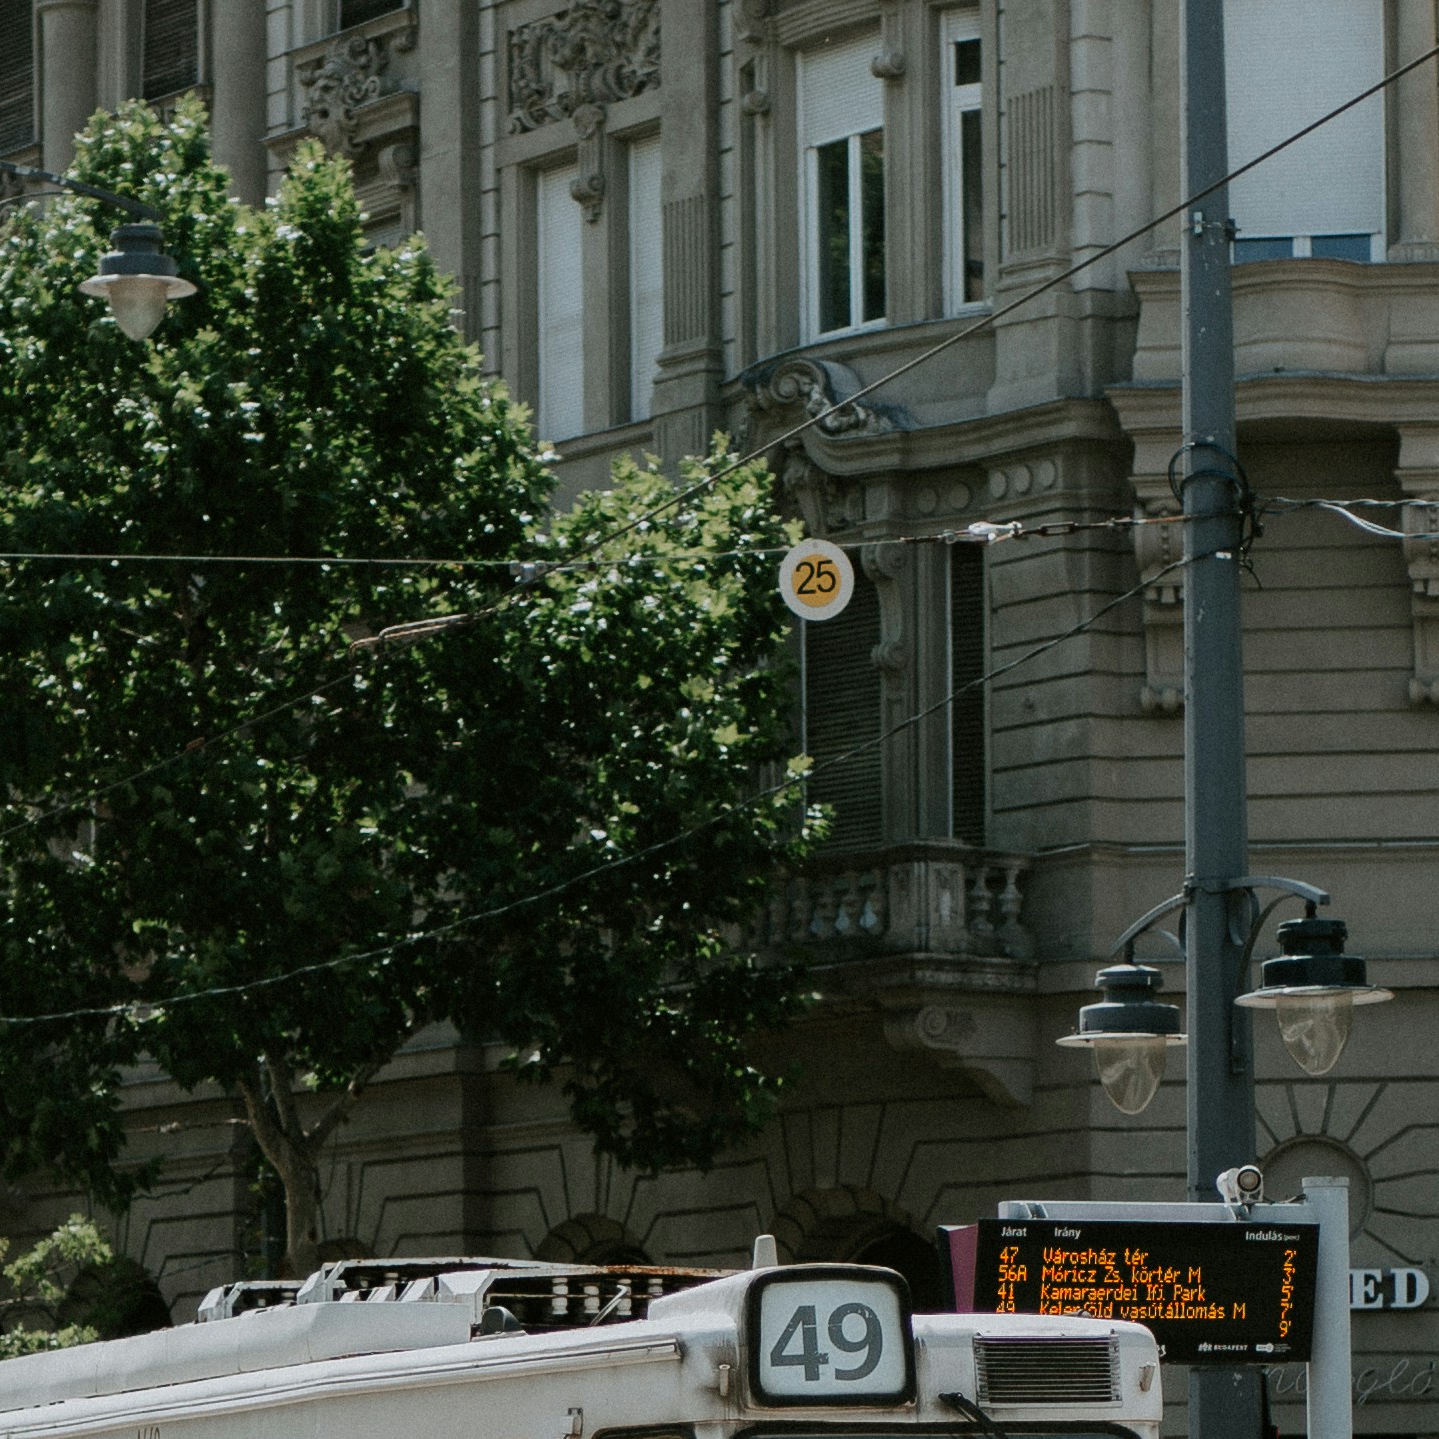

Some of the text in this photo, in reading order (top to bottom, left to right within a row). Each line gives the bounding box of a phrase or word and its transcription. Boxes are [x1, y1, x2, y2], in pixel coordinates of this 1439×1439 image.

[795, 560, 837, 595] 25
[1001, 1227, 1027, 1238] Járat
[1054, 1226, 1081, 1240] Irány
[1245, 1230, 1282, 1241] Indulás
[999, 1246, 1019, 1263] 47
[1043, 1247, 1116, 1265] Városház
[1124, 1247, 1149, 1265] tér
[998, 1264, 1027, 1281] 56A
[1042, 1265, 1097, 1283] Móricz
[1188, 1266, 1201, 1283] M
[997, 1282, 1014, 1299] 41
[1040, 1283, 1137, 1301] Kamaraerdei
[1174, 1284, 1206, 1301] Park
[1233, 1302, 1246, 1319] M
[770, 1302, 883, 1381] 49
